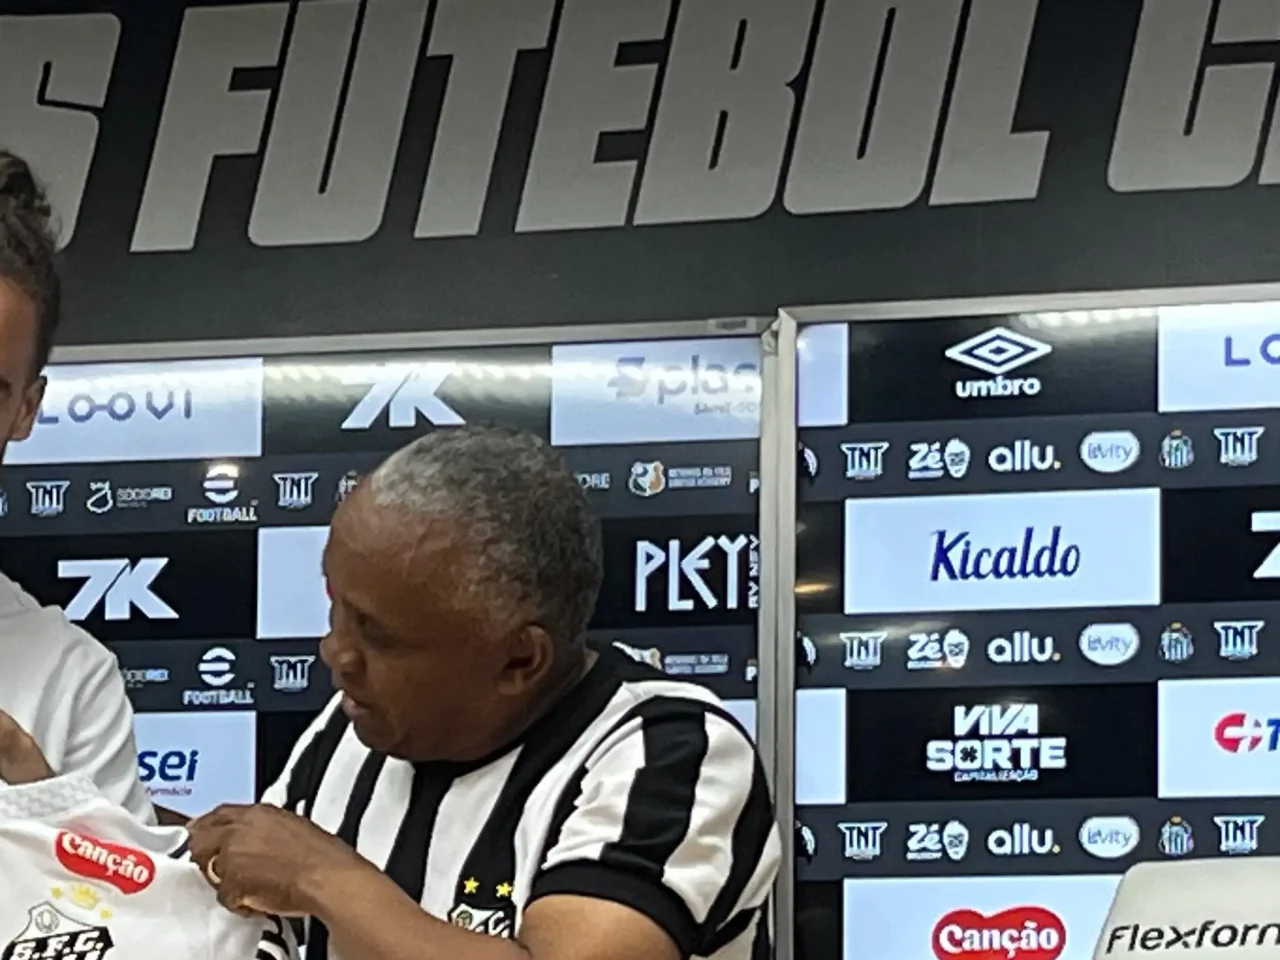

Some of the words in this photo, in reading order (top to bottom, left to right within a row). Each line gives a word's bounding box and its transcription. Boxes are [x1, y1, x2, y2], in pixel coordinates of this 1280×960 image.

[129, 0, 1050, 253] FUTEBOL
[956, 375, 1042, 398] umbro
[186, 507, 258, 523] FOOTBALL
[928, 525, 1081, 582] Kicaldo
[58, 556, 179, 620] 7K
[183, 689, 255, 705] FOOTBALL
[953, 703, 1039, 736] VIVA
[137, 749, 200, 783] sei
[926, 737, 1067, 771] SORTE
[61, 830, 150, 885] Canção
[938, 921, 1060, 960] Canção
